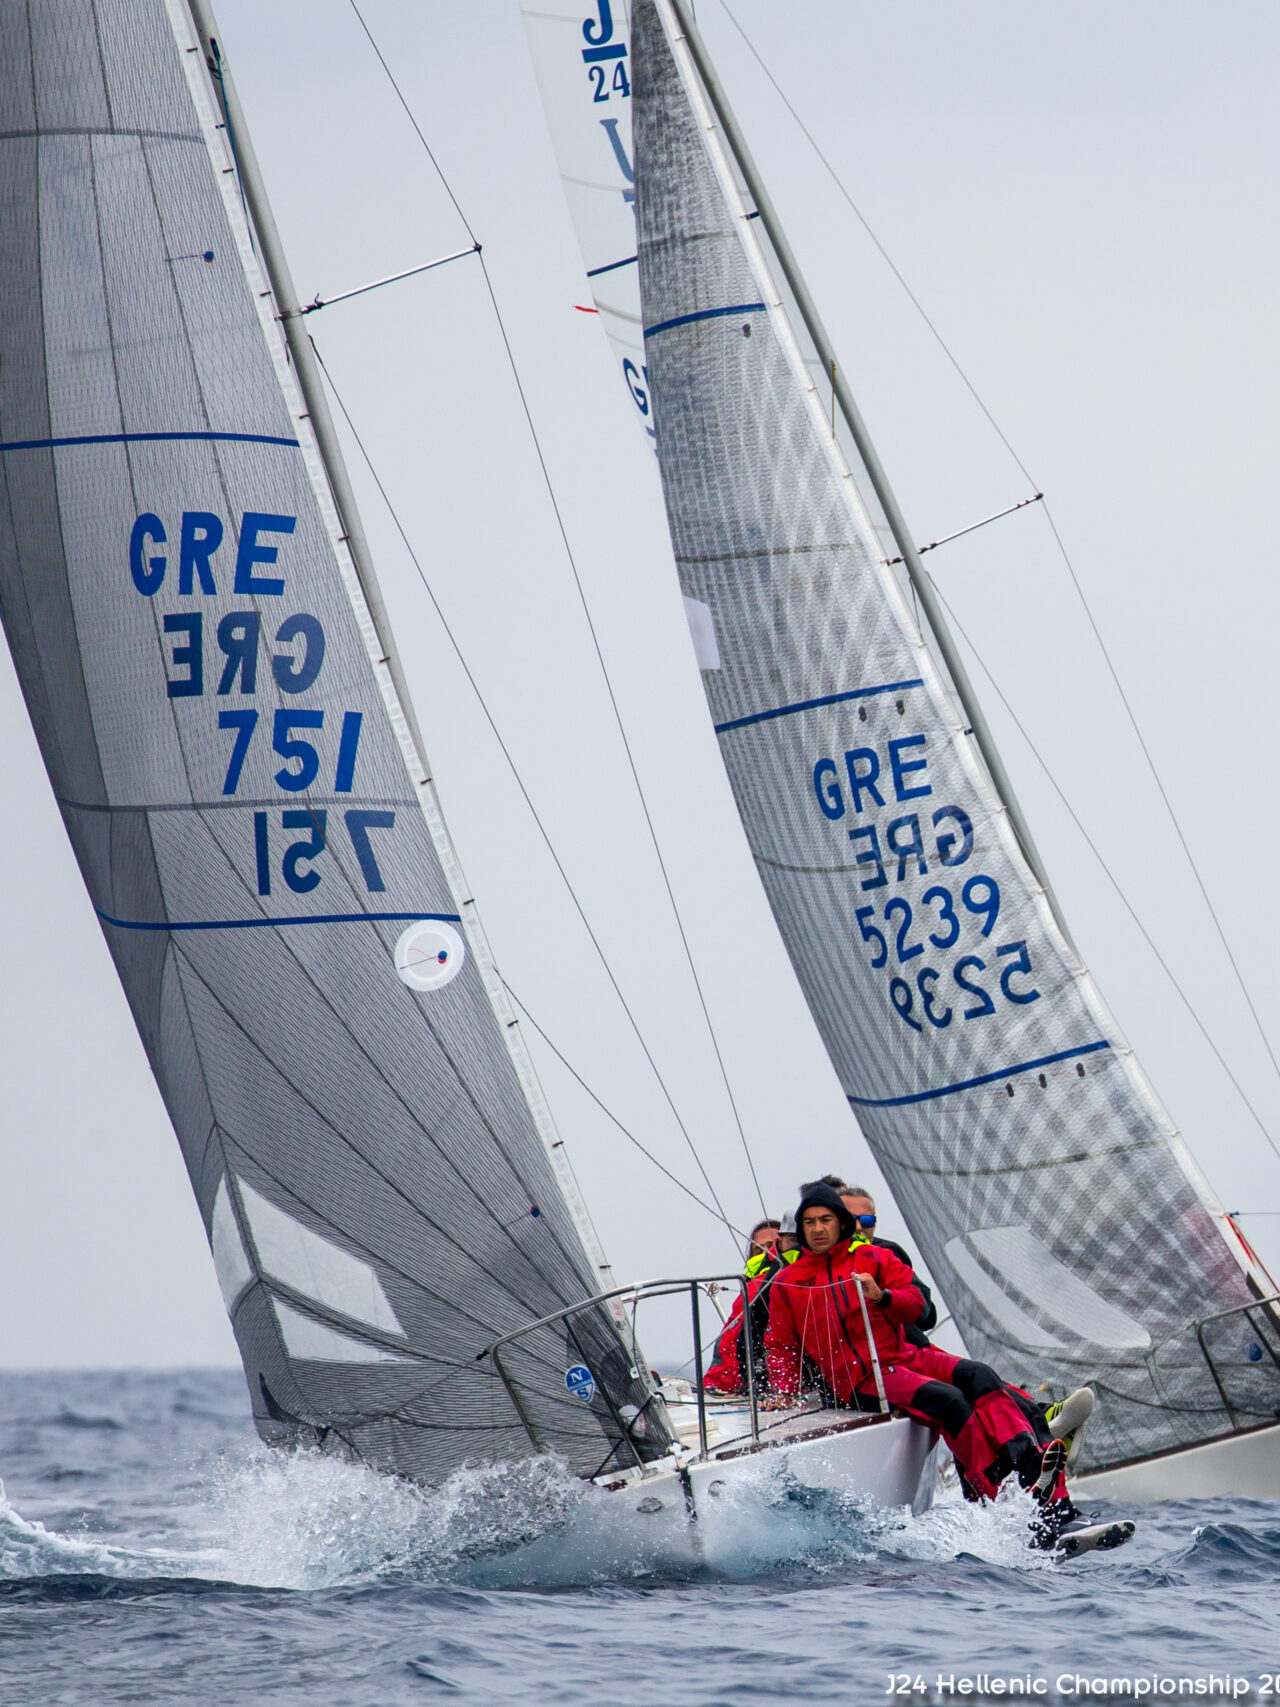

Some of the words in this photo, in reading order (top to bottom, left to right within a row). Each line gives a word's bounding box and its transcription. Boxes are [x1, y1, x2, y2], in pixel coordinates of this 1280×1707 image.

[588, 60, 631, 103] 24
[129, 511, 297, 597] GRE
[218, 708, 363, 795] 751
[813, 734, 932, 820] GRE
[855, 874, 1001, 969] 5239
[570, 1370, 583, 1382] N
